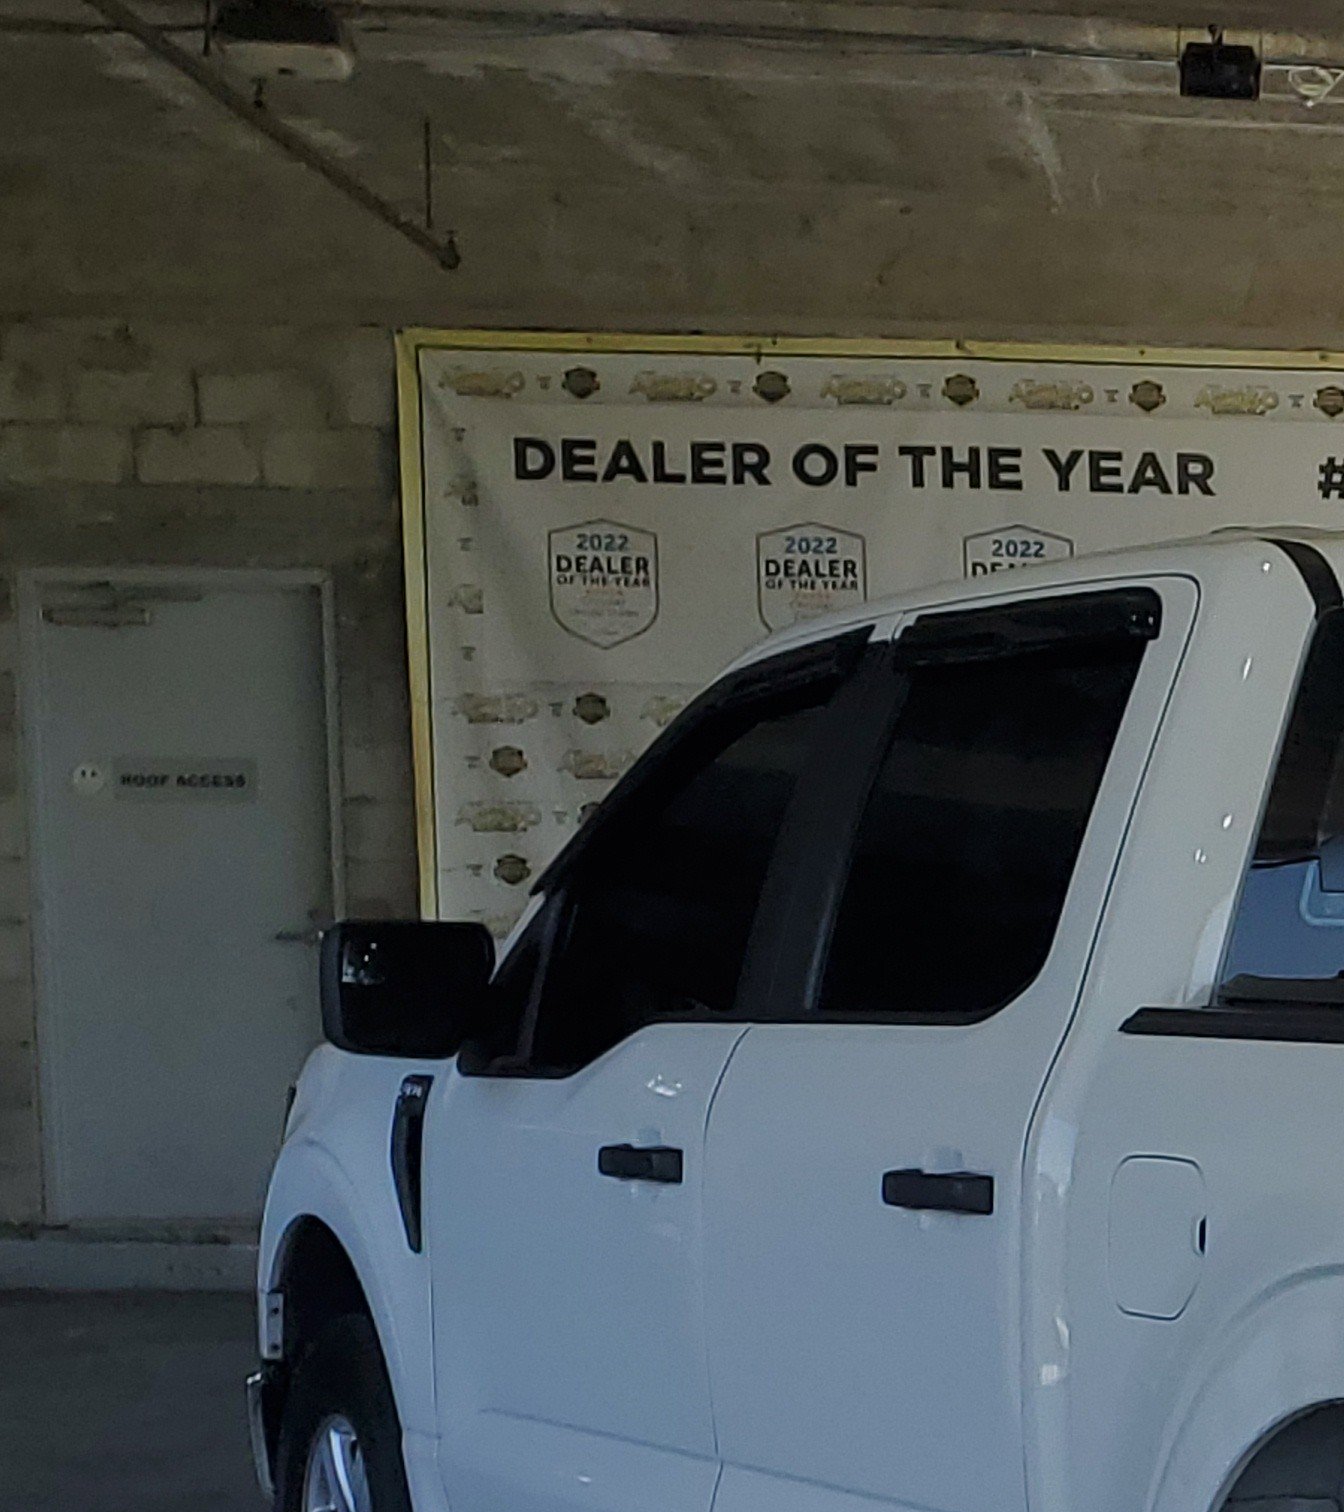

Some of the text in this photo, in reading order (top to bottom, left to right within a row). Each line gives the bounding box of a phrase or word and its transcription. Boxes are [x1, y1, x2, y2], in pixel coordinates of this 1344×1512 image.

[513, 437, 1216, 496] DEALER OF THE YEAR
[576, 533, 629, 551] 2022
[785, 537, 837, 554] 2022
[992, 540, 1045, 558] 2022
[556, 554, 649, 575] DEALER
[765, 559, 858, 578] DEALER
